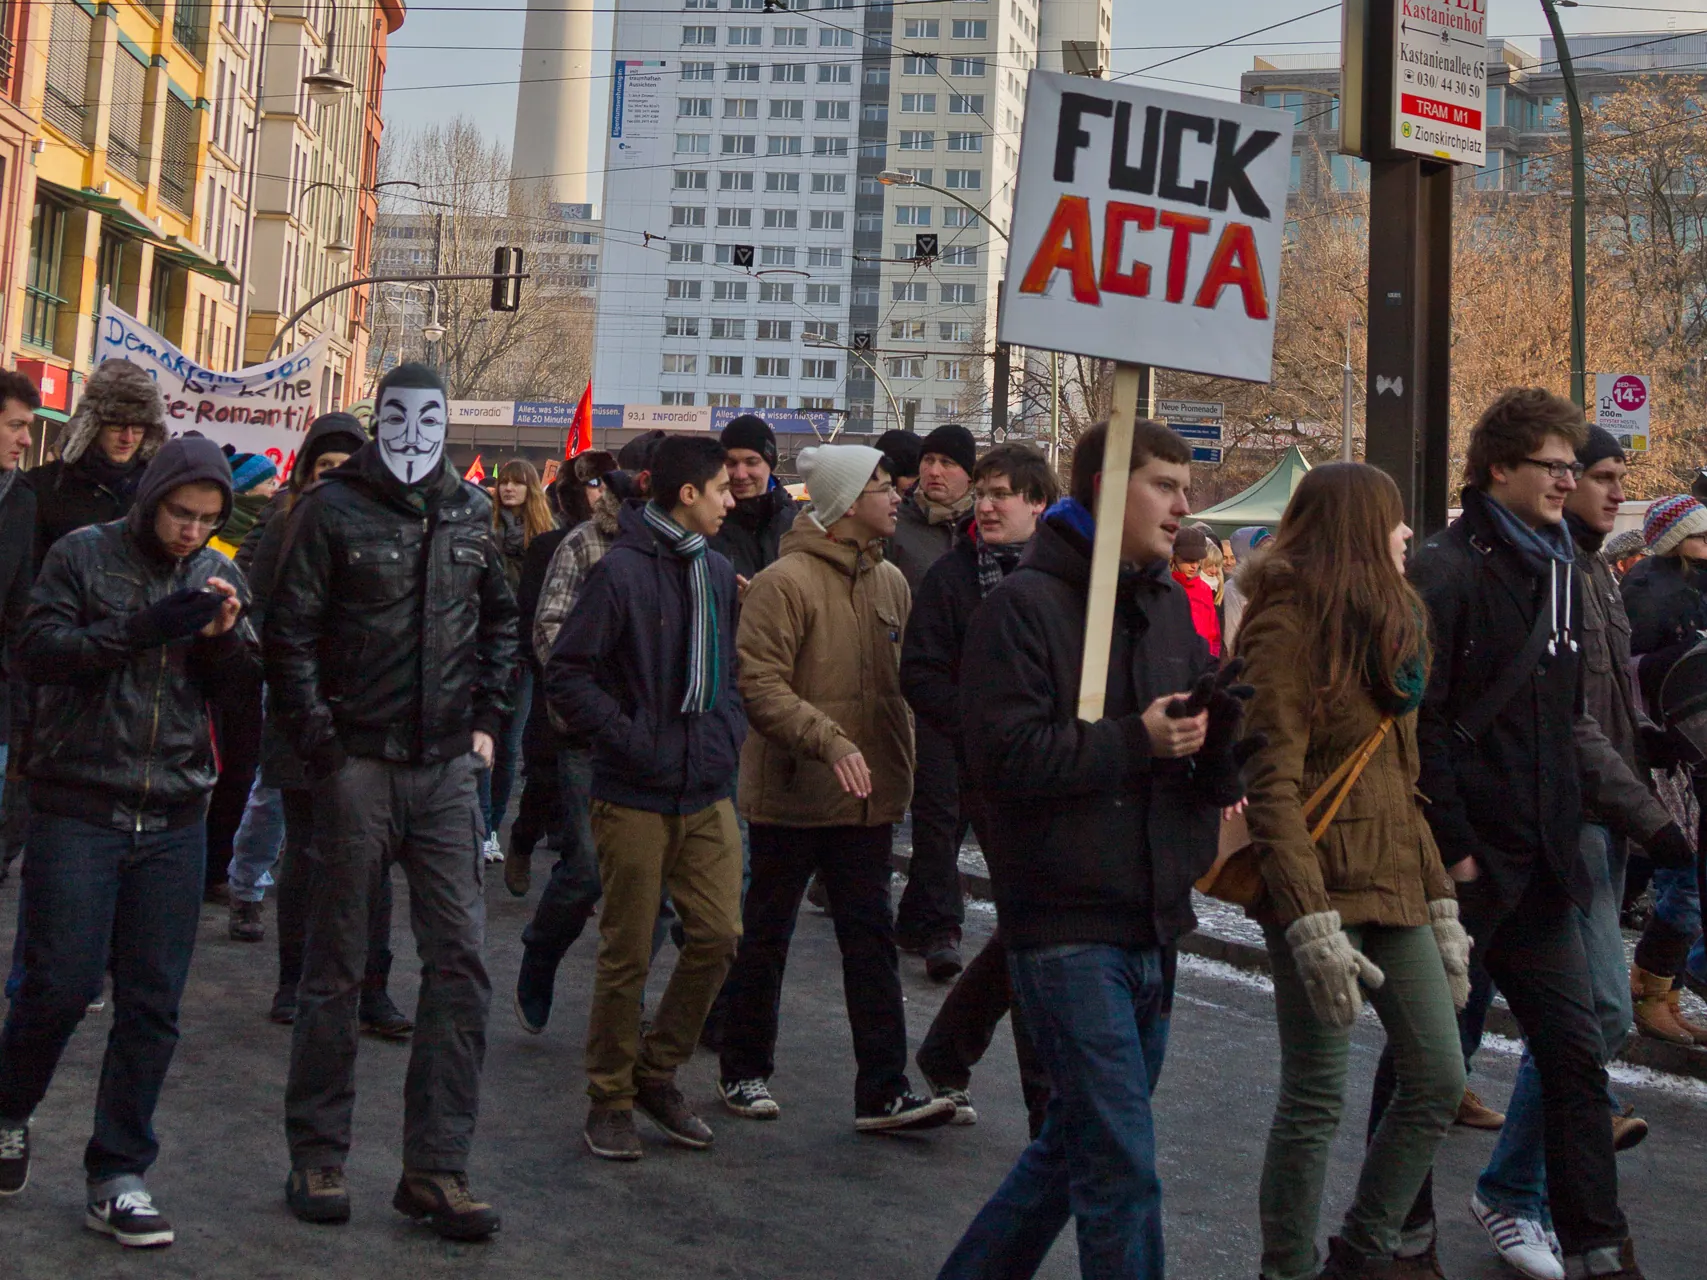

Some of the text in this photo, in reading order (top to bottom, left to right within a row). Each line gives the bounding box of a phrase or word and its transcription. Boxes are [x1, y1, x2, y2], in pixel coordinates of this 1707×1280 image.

[1400, 42, 1484, 80] Kastanienallee 65
[1417, 71, 1480, 98] 030/ 44 30 50
[613, 68, 623, 136] Eigentumswohnungen
[1416, 99, 1468, 124] TRAM M1
[1415, 125, 1481, 153] Zionskirchplatz
[1053, 92, 1281, 221] FUCK
[1019, 193, 1270, 321] ACTA
[459, 408, 501, 417] INFOradio
[517, 415, 531, 423] Alle
[532, 415, 541, 423] 20
[518, 405, 537, 414] Alles,
[554, 406, 565, 414] Sie
[628, 412, 645, 421] 93,1
[652, 412, 697, 422] INFOradio
[715, 410, 735, 419] Alles,
[767, 412, 792, 420] wissen
[1161, 402, 1218, 413] Neue Promenade
